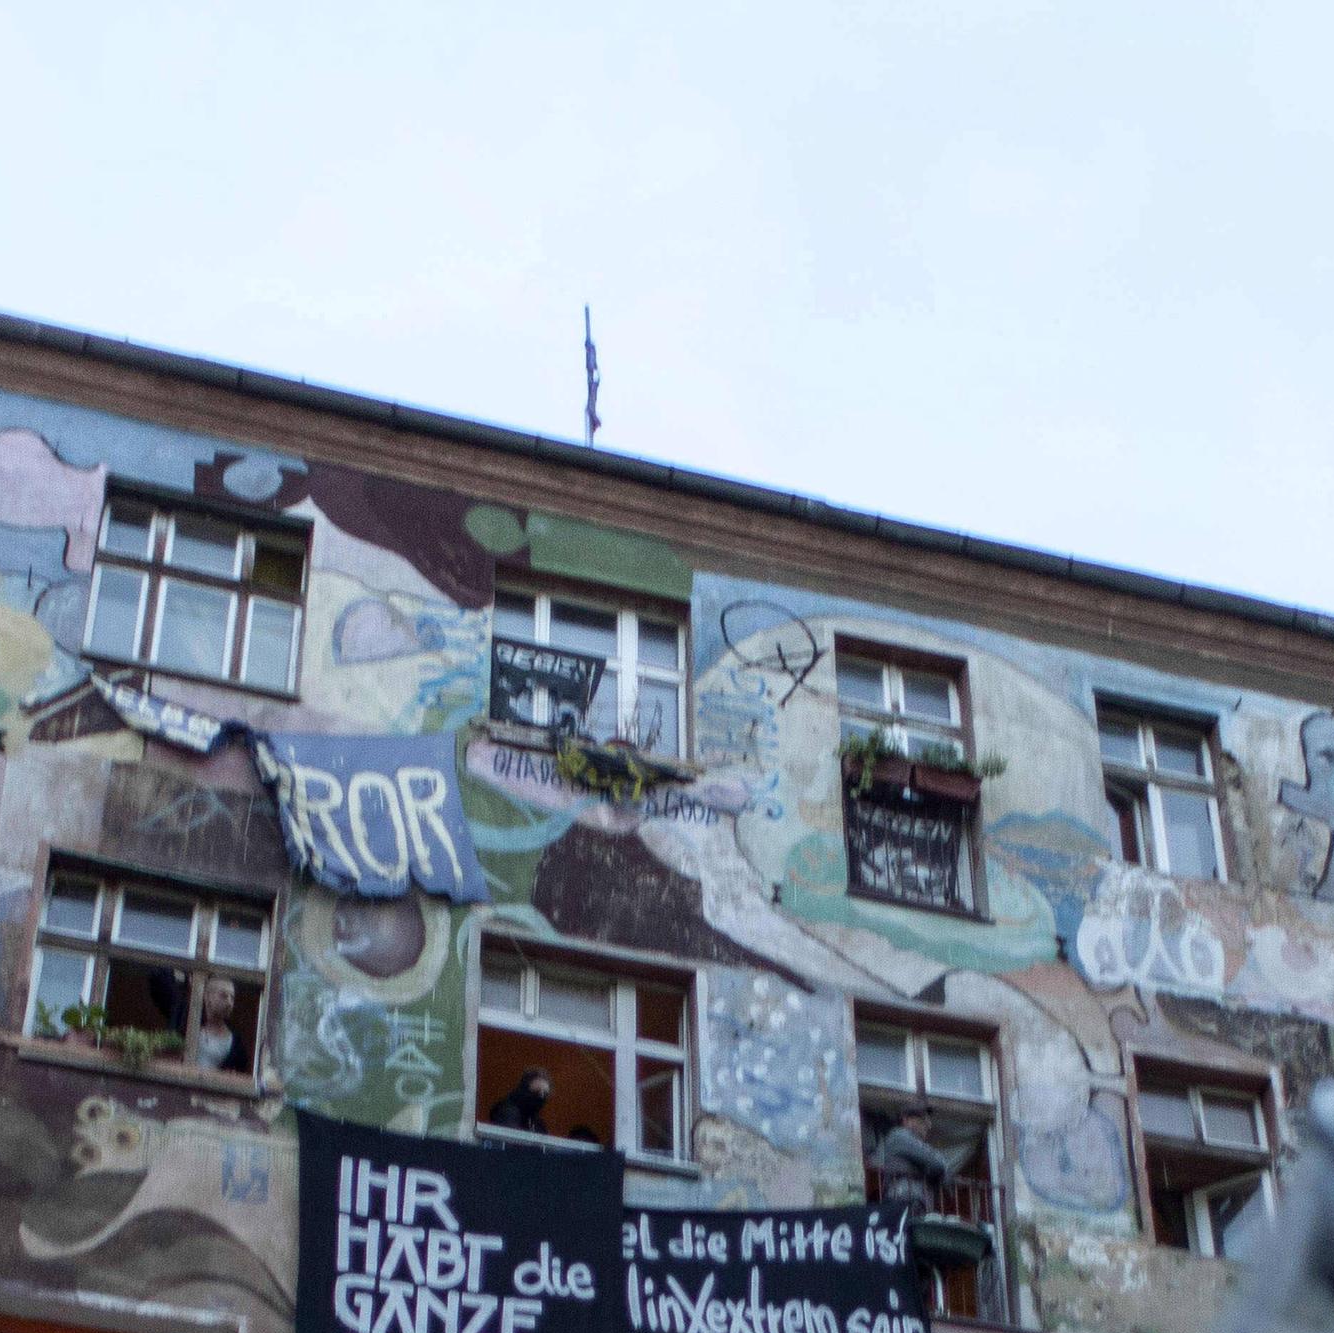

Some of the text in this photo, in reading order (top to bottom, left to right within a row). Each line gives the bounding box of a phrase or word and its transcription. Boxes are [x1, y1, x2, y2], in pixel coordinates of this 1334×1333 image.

[339, 1156, 460, 1231] IHR
[334, 1212, 596, 1300] HABT die
[668, 1219, 728, 1265] die
[741, 1216, 854, 1264] Mitte
[865, 1205, 910, 1266] ist
